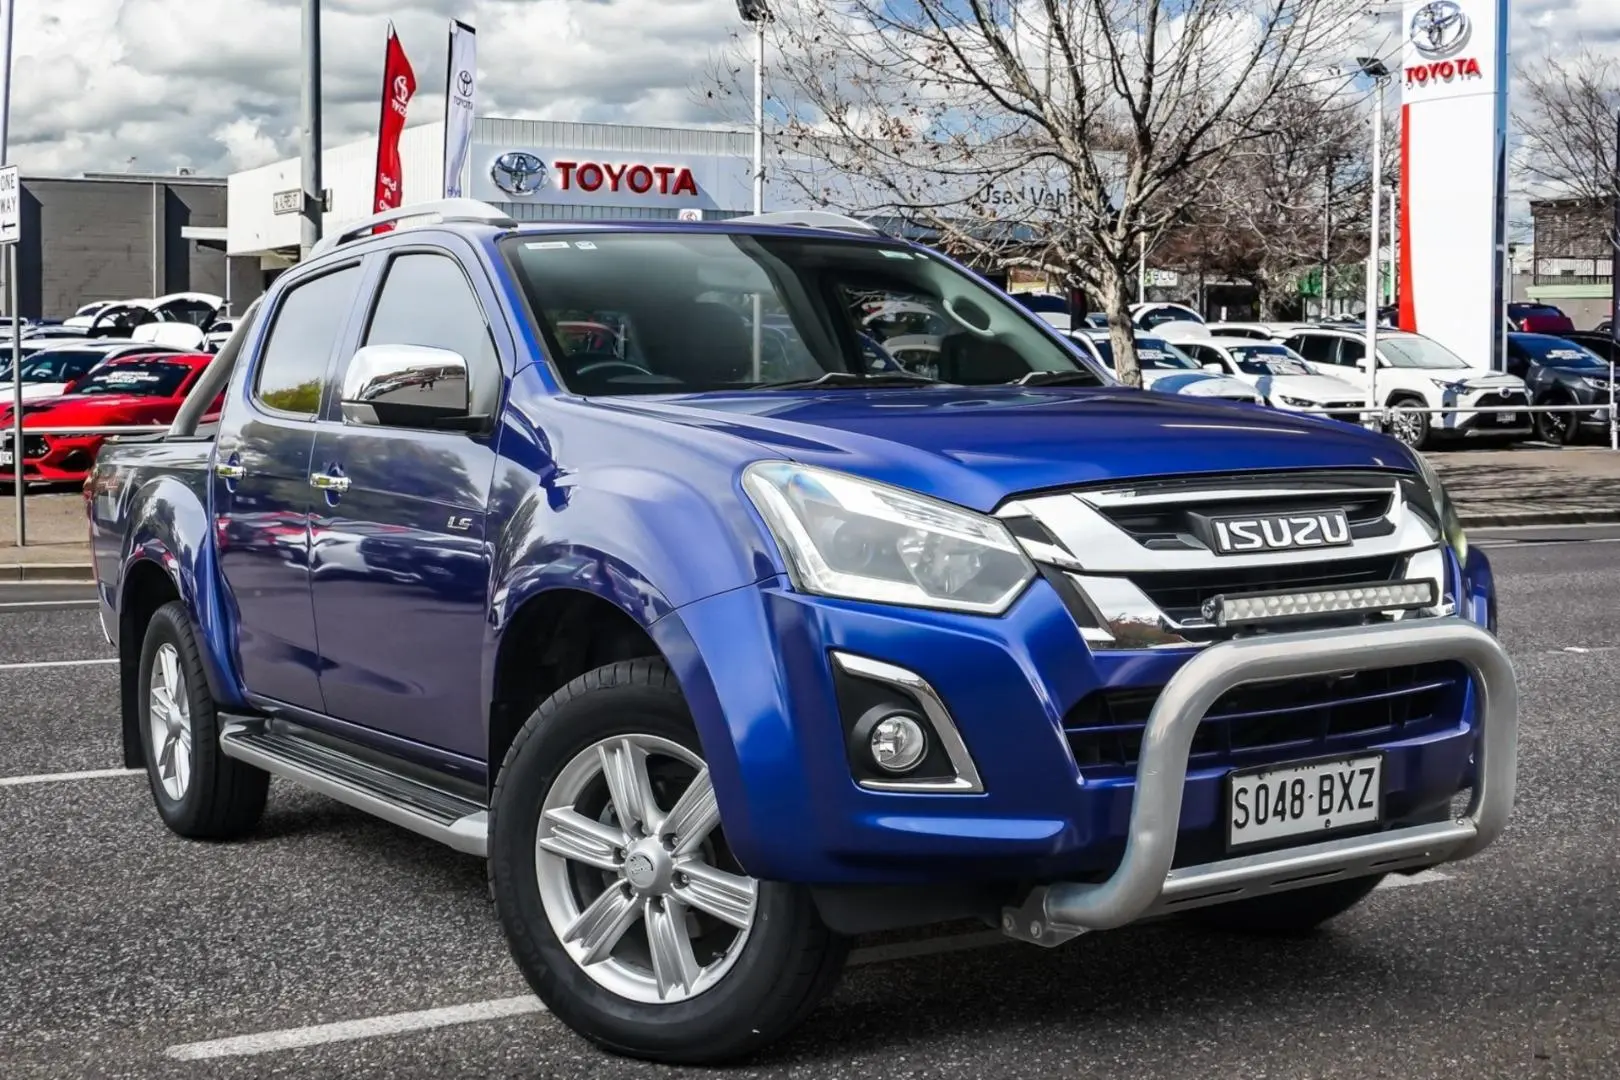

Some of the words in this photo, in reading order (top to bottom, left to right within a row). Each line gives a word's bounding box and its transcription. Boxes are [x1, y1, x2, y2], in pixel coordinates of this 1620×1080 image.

[1404, 58, 1481, 83] TOYOTA
[0, 173, 15, 191] ONE
[555, 161, 698, 196] TOYOTA
[0, 196, 16, 213] WAY
[447, 515, 472, 530] LS
[1215, 515, 1348, 550] ISUZU
